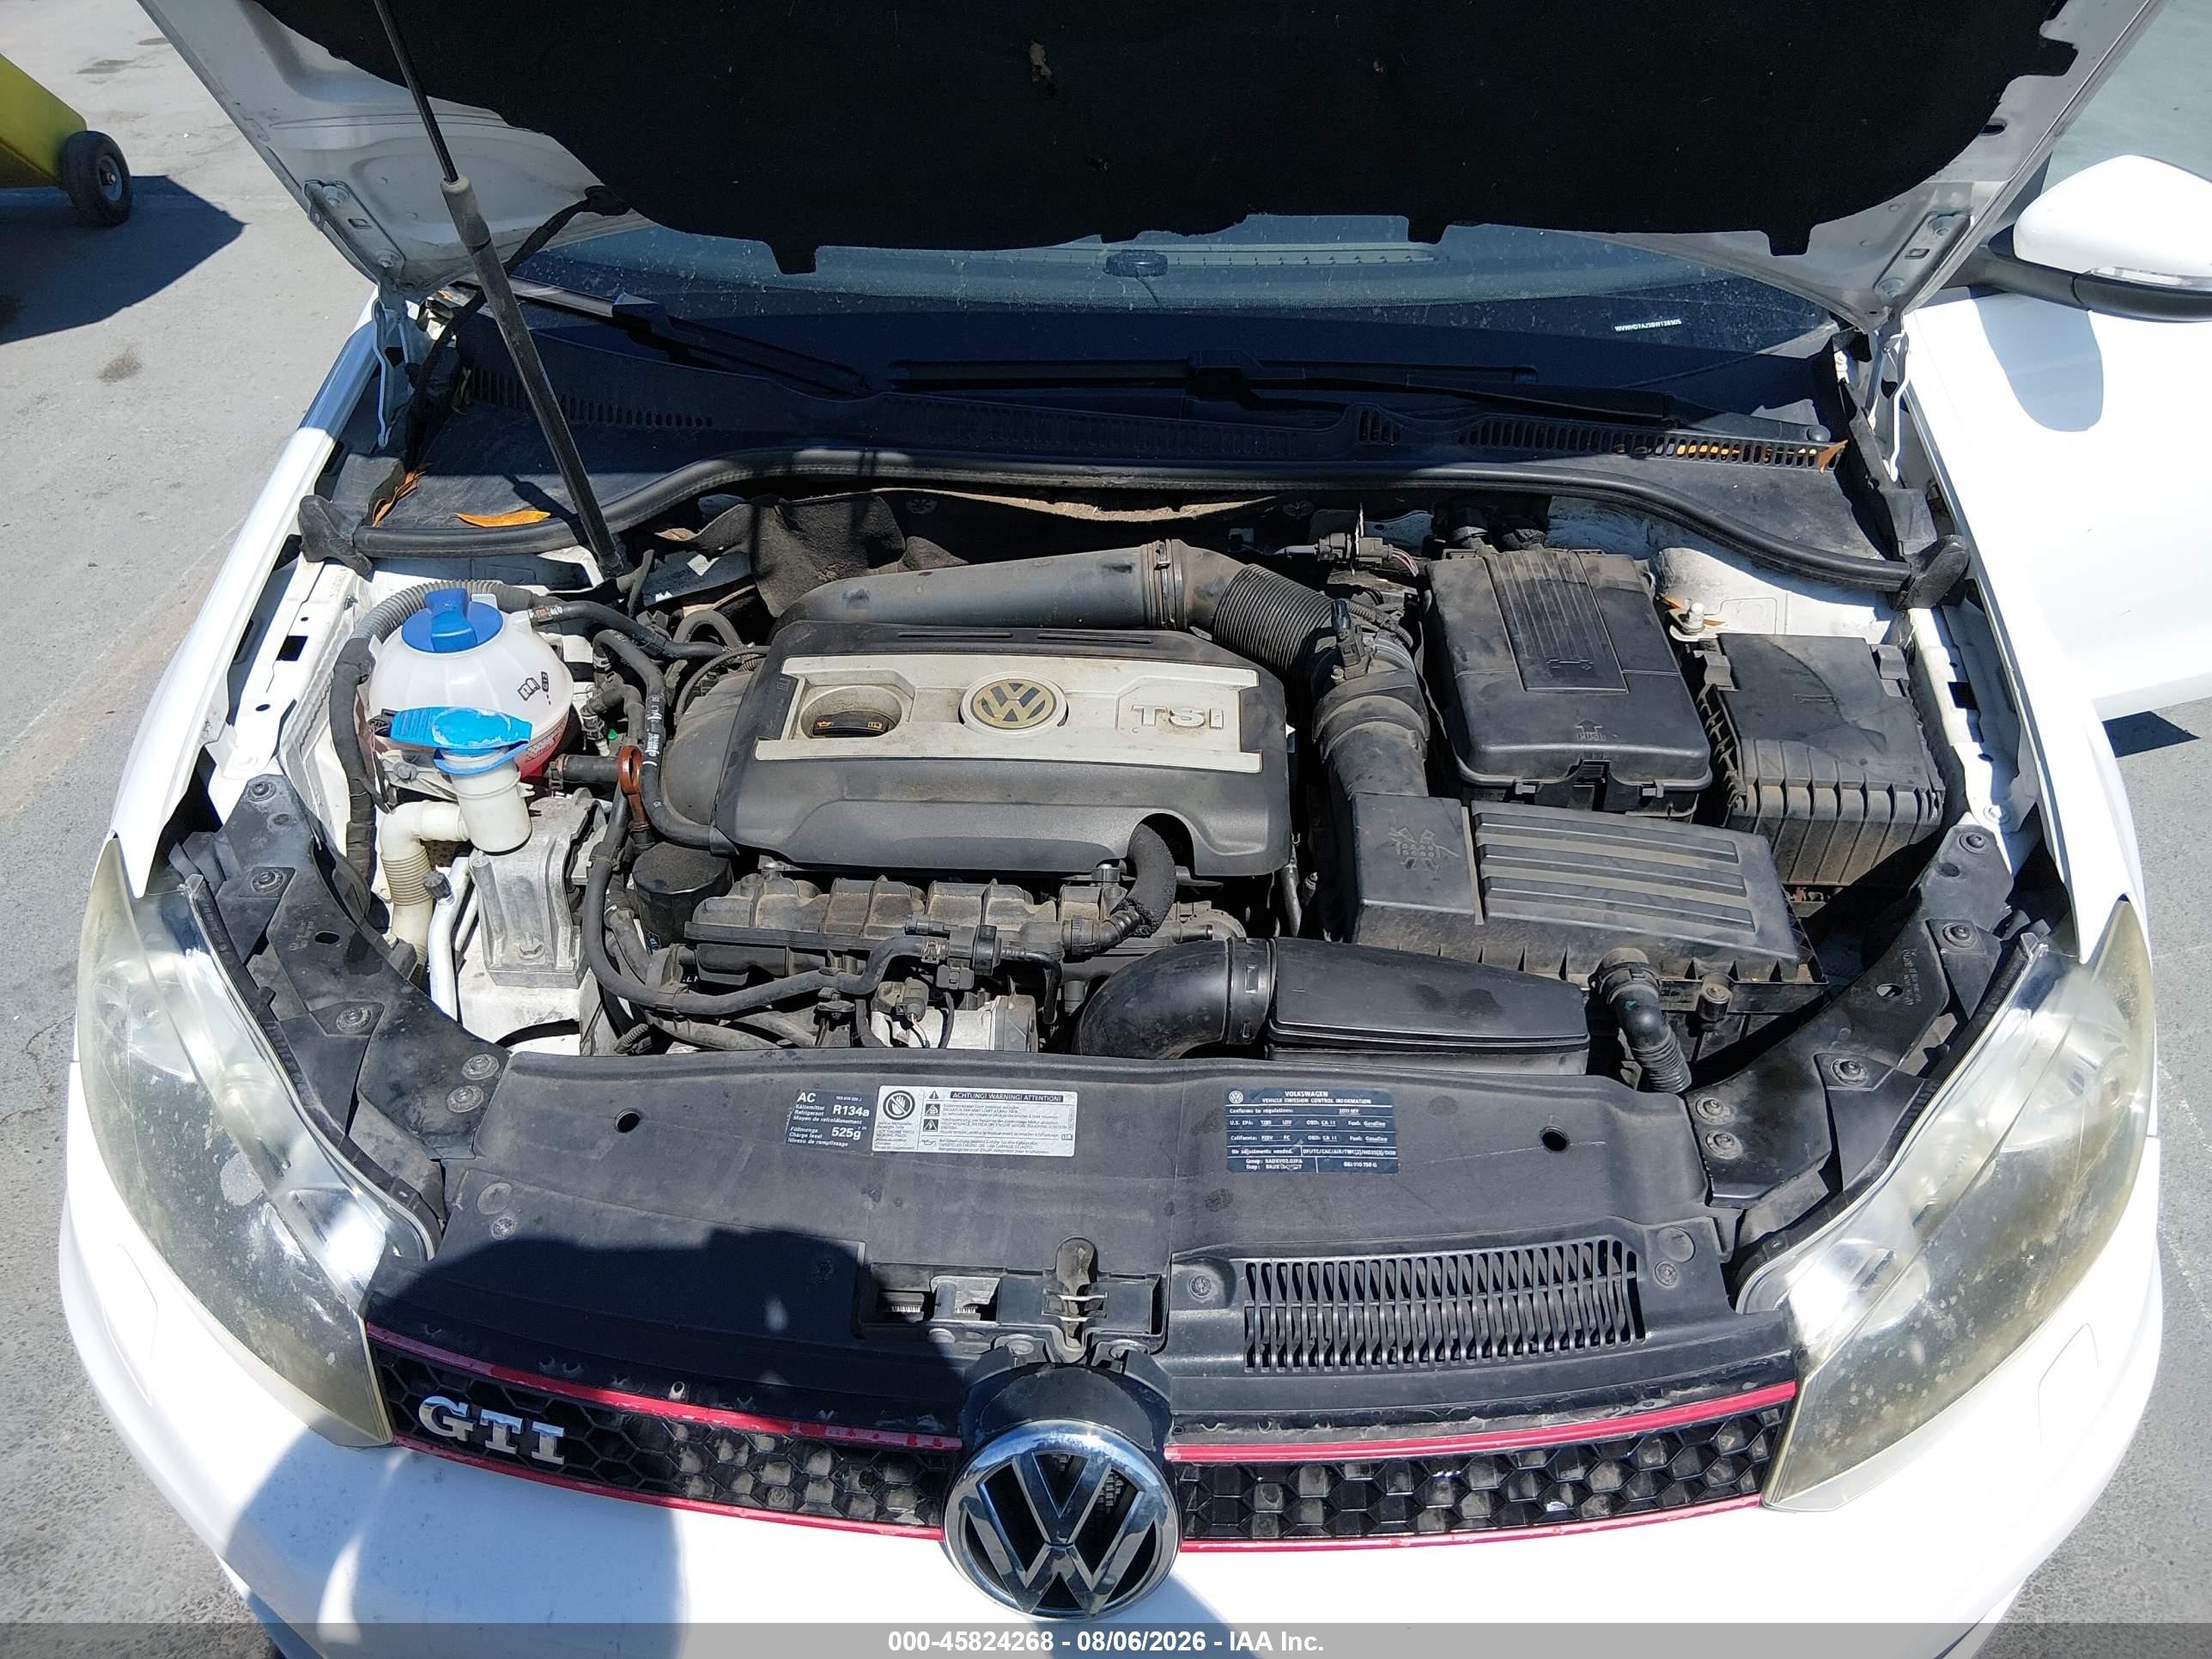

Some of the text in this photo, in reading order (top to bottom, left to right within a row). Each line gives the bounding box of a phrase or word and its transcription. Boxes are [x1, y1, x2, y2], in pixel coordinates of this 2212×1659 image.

[1130, 705, 1224, 730] TSI
[797, 1092, 817, 1103] AC
[832, 1104, 870, 1117] R134a
[831, 1127, 861, 1140] 525g
[419, 1395, 564, 1465] GTI
